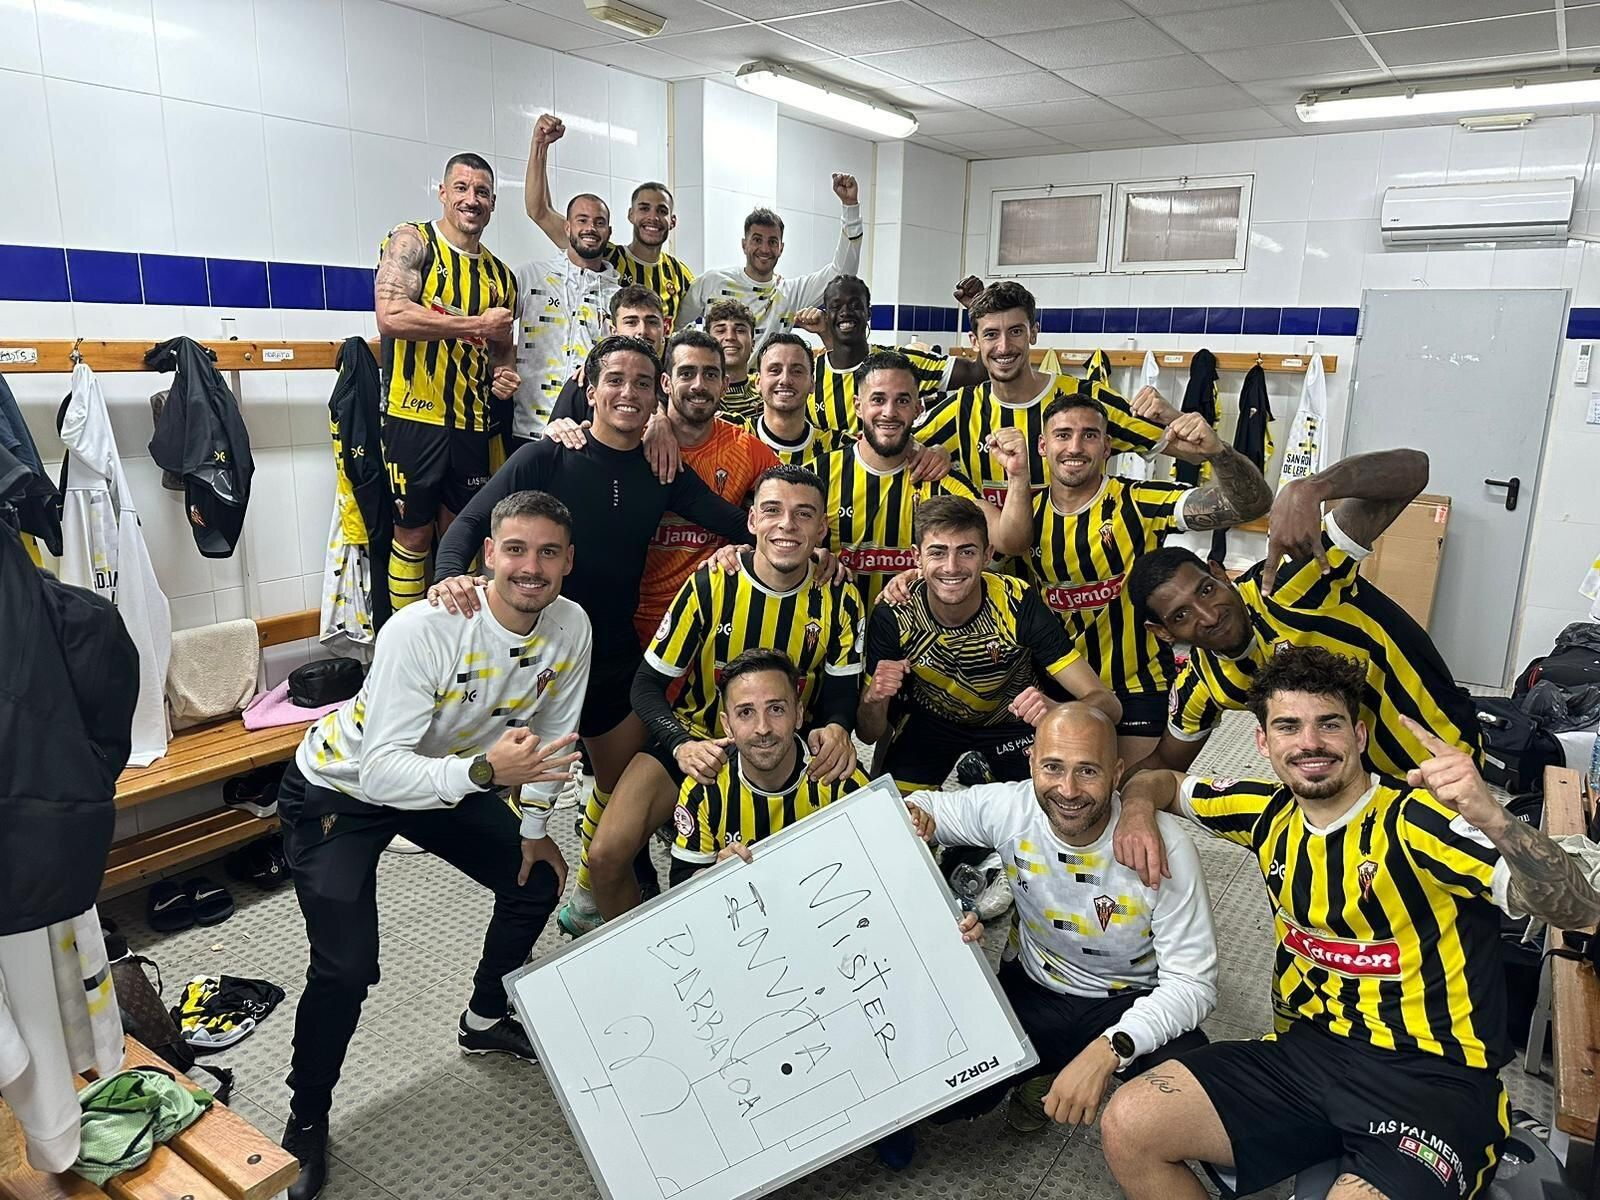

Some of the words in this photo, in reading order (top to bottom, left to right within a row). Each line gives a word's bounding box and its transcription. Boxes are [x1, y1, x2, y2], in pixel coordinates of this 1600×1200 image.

[401, 392, 434, 413] Lepe
[1286, 453, 1300, 464] SAN
[1283, 464, 1292, 474] DE
[1292, 465, 1307, 476] LEPE
[387, 462, 406, 495] 14
[1049, 589, 1063, 605] el
[996, 741, 1015, 755] LAS
[945, 1055, 1000, 1088] FORZA
[1369, 1120, 1397, 1135] LAS
